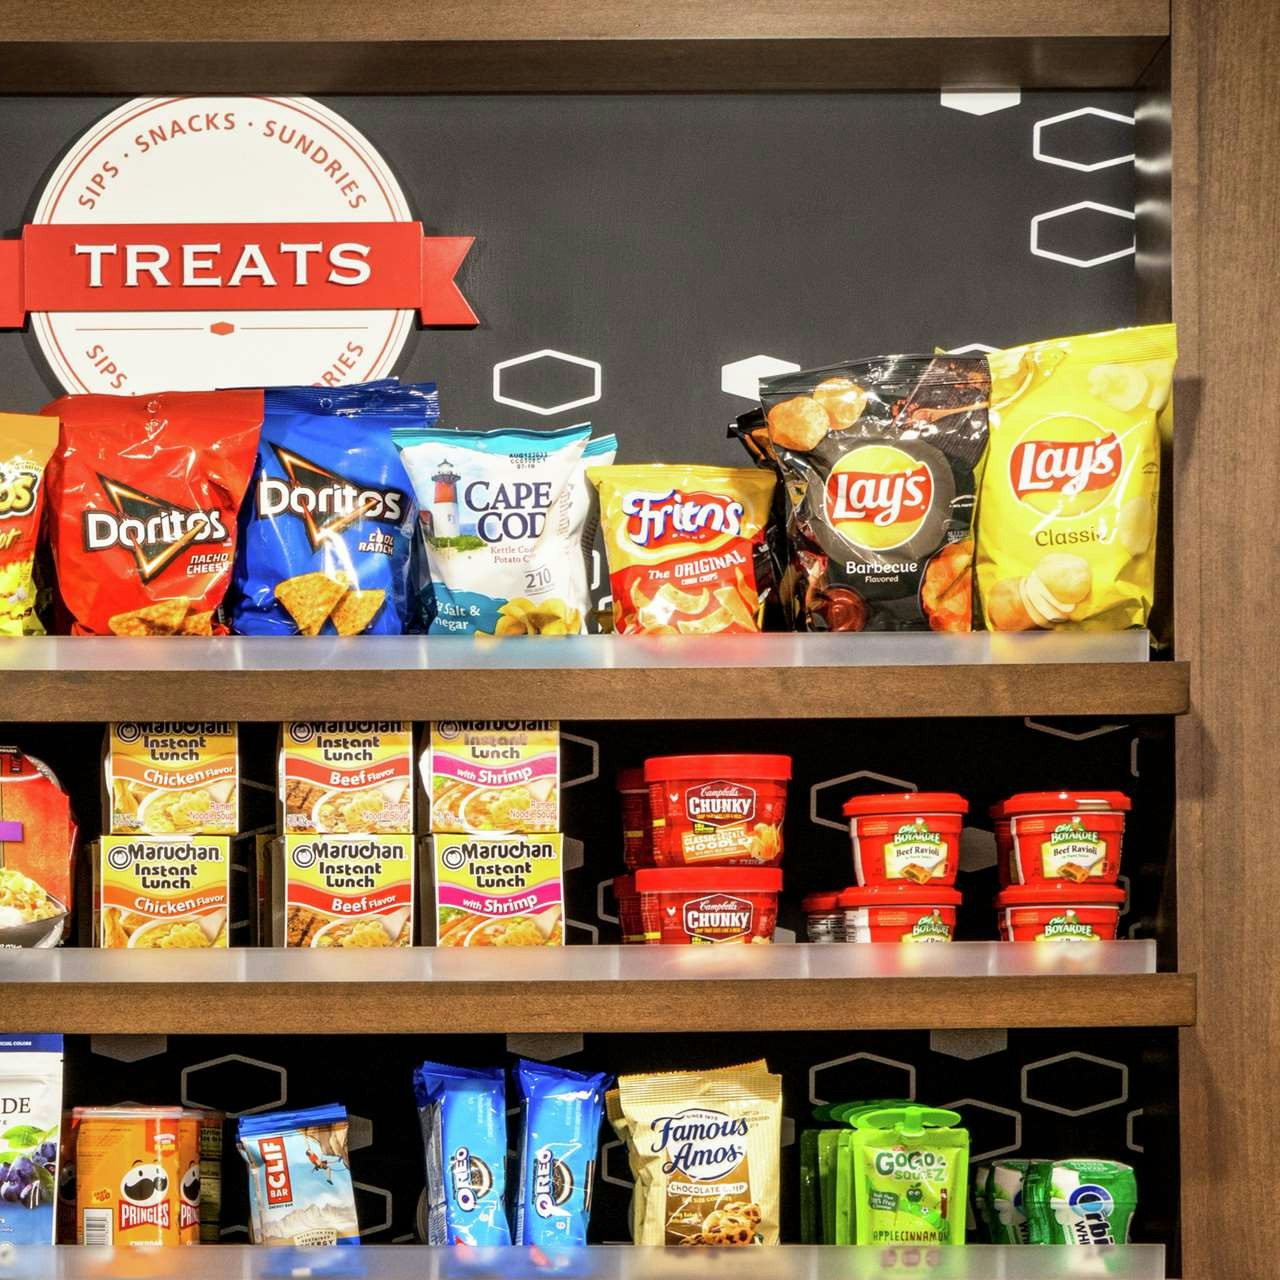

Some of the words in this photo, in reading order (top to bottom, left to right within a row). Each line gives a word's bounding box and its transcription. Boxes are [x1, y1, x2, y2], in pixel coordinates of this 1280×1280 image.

[79, 161, 119, 209] SIPS
[135, 113, 236, 153] SNACKS
[263, 120, 366, 209] SUNDRIES
[75, 243, 372, 287] TREATS
[86, 344, 127, 388] SIPS
[1019, 432, 1117, 494] Lay's
[259, 479, 402, 519] Doritos
[465, 482, 552, 512] CAPE
[832, 465, 927, 527] Lay's
[623, 490, 744, 545] Fritos
[87, 511, 227, 548] Doritos
[478, 512, 548, 544] COD
[491, 546, 515, 554] Kettle
[187, 564, 229, 574] CHEESE
[648, 570, 670, 579] The
[674, 551, 746, 578] ORIGINAL
[846, 560, 918, 576] Barbecue
[525, 568, 551, 589] 210
[864, 575, 899, 584] Flavored
[444, 604, 466, 617] Salt
[469, 606, 480, 617] &
[139, 721, 231, 733] Maruchan
[312, 721, 402, 732] Maruchan
[144, 736, 206, 748] Instant
[317, 736, 380, 748] Instant
[464, 734, 526, 746] Instant
[151, 749, 199, 761] Lunch
[324, 750, 372, 761] Lunch
[472, 748, 520, 759] Lunch
[144, 769, 204, 787] Chicken
[206, 766, 233, 777] Flavor
[330, 772, 367, 786] Beef
[368, 768, 395, 780] Flavor
[457, 768, 476, 780] with
[480, 767, 532, 782] Shrimp
[689, 798, 751, 815] CHUNKY
[128, 845, 220, 861] Maruchan
[313, 842, 404, 858] Maruchan
[462, 842, 552, 858] Maruchan
[896, 847, 913, 856] Beef
[915, 846, 939, 856] Ravioli
[1054, 848, 1069, 856] Beef
[1072, 846, 1097, 854] Ravioli
[135, 864, 197, 876] Instant
[320, 863, 382, 874] Instant
[470, 863, 532, 874] Instant
[142, 877, 190, 889] Lunch
[326, 876, 374, 888] Lunch
[476, 876, 525, 888] Lunch
[135, 897, 195, 915] Chicken
[197, 894, 224, 905] Flavor
[332, 899, 367, 912] Beef
[369, 894, 396, 908] Flavor
[463, 899, 482, 909] with
[483, 894, 538, 912] Shrimp
[687, 911, 749, 928] CHUNKY
[651, 1118, 748, 1152] Famous
[263, 1142, 286, 1188] CLIF
[662, 1143, 743, 1174] Amos
[452, 1147, 476, 1212] OREO
[535, 1148, 555, 1218] OREO
[270, 1189, 288, 1197] BAR
[671, 1185, 720, 1193] CHOCOLATE
[122, 1203, 168, 1227] PRINGLES
